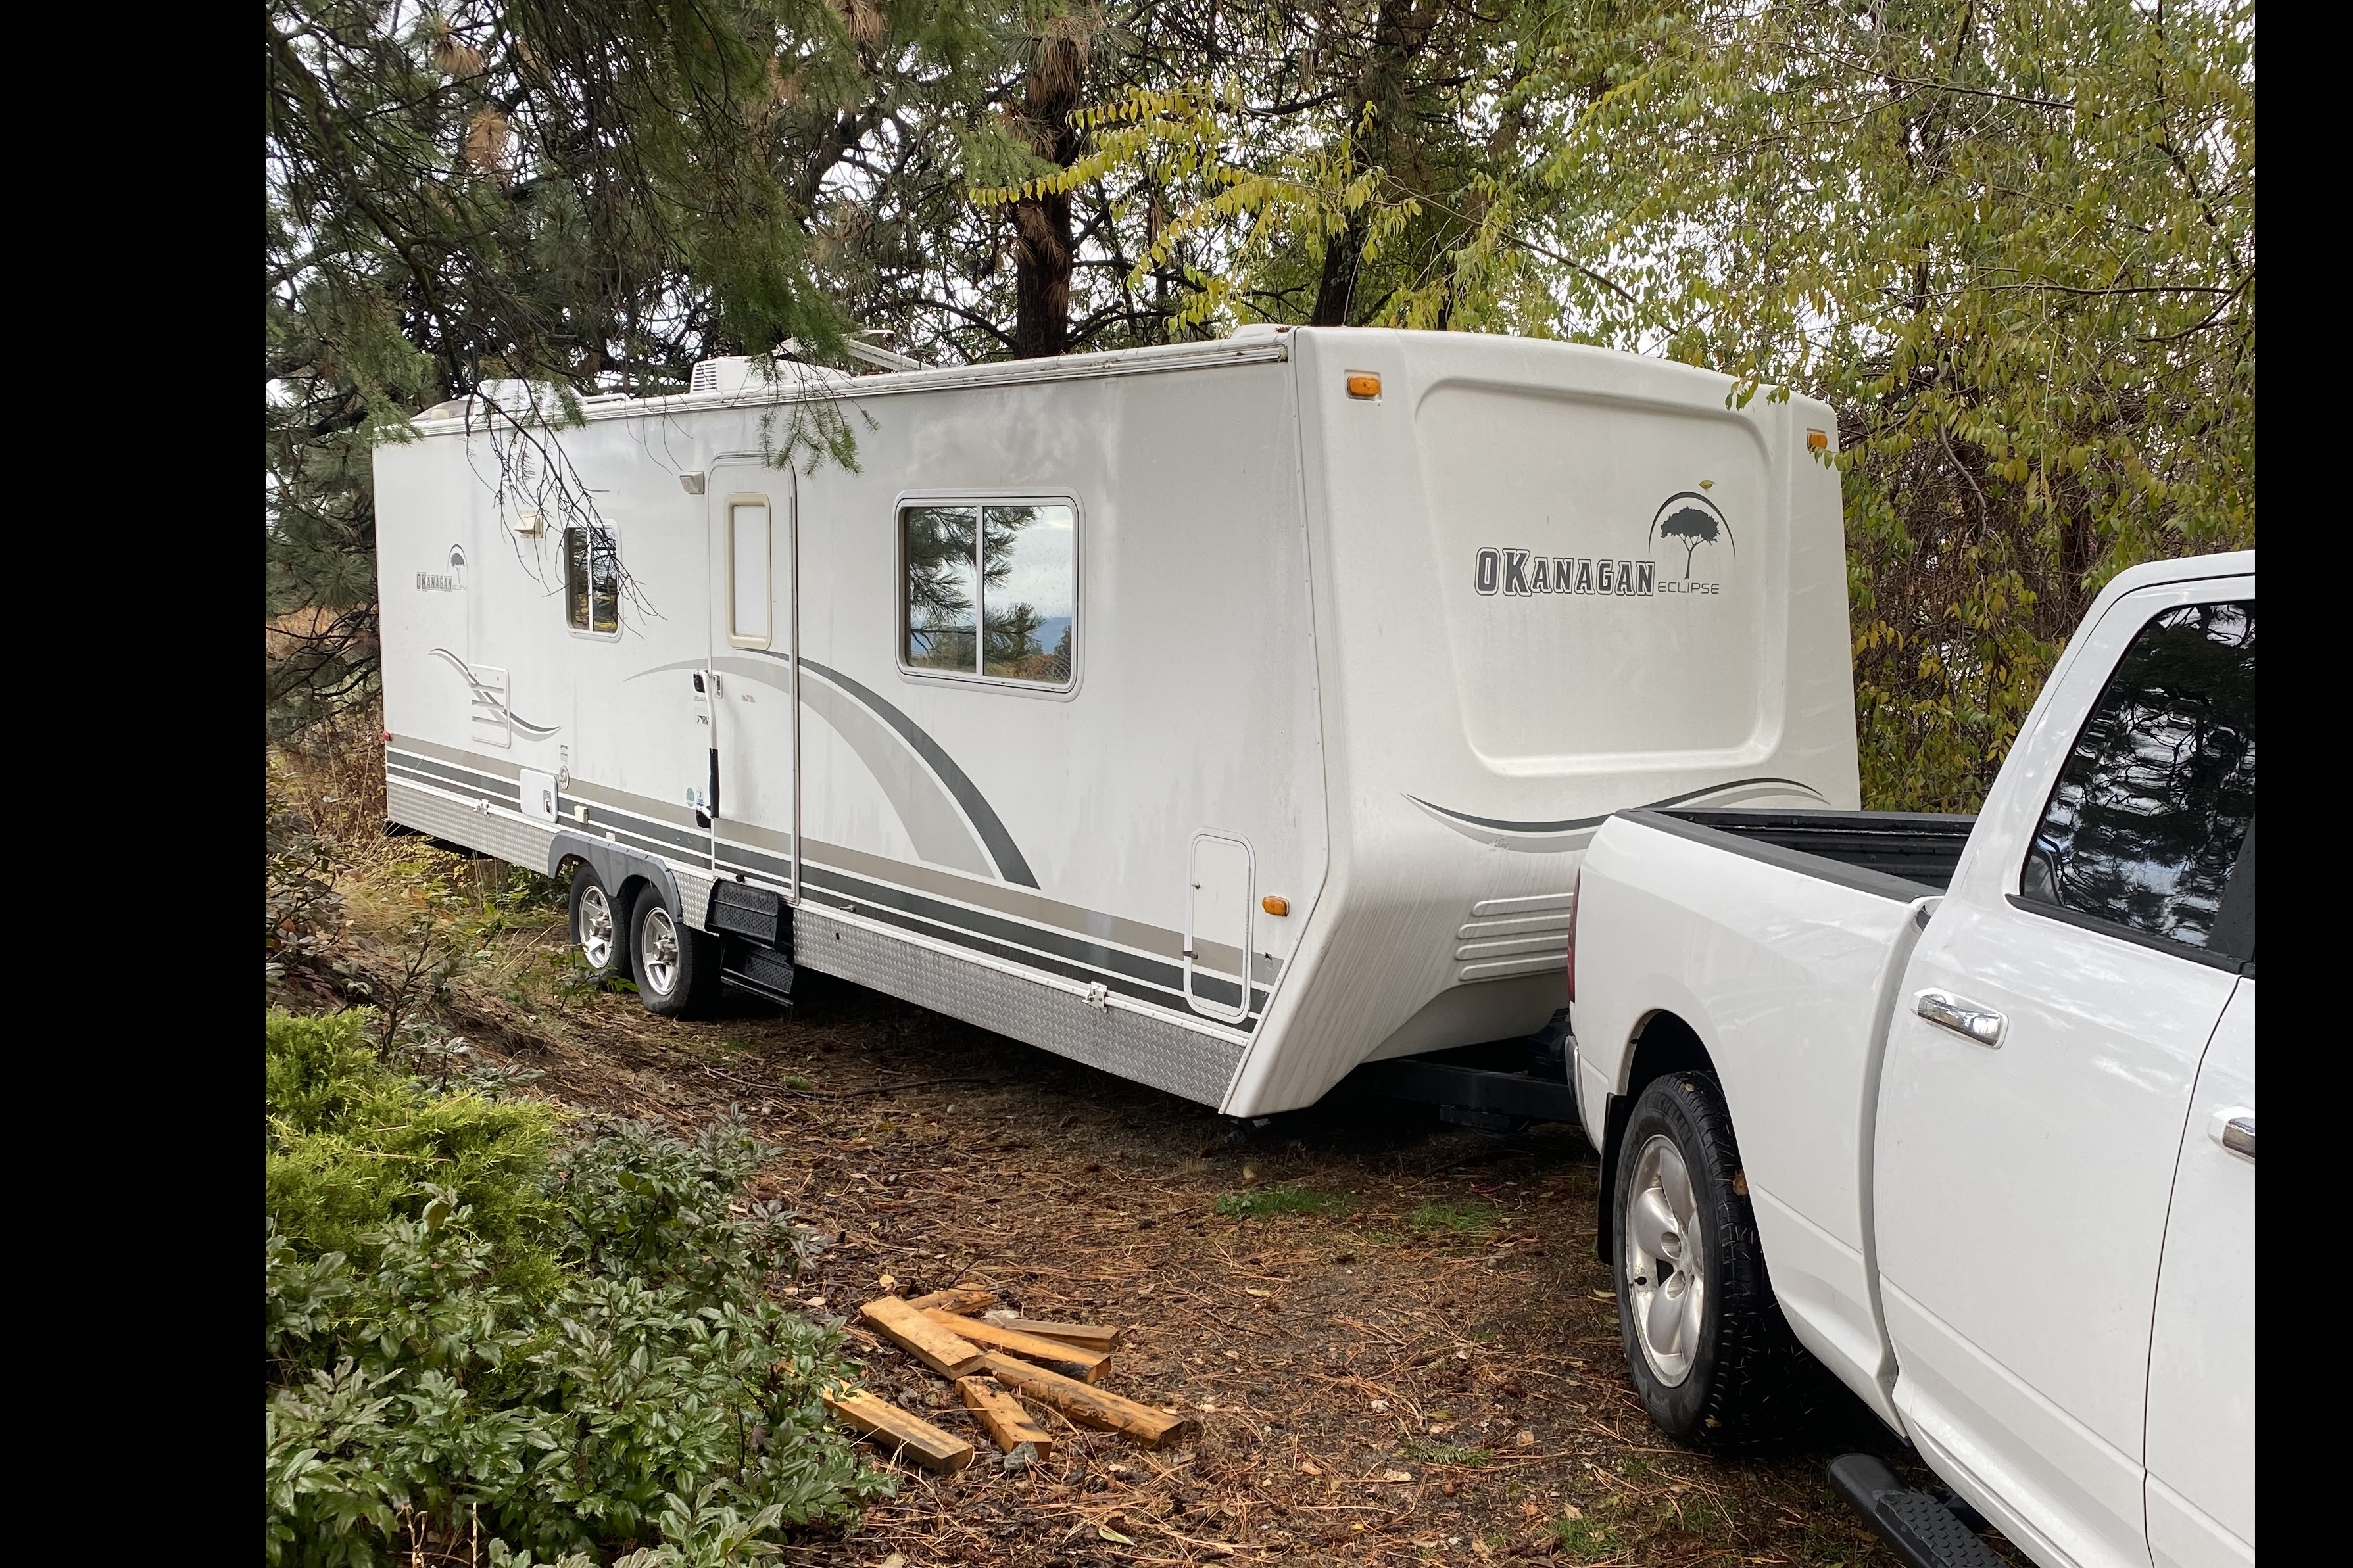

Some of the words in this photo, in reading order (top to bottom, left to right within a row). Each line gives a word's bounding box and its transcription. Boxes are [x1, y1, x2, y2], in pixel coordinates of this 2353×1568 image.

[416, 571, 452, 592] OKANAGAN
[1474, 547, 1655, 596] OKANAGAN
[1657, 581, 1720, 594] ECLIPSE
